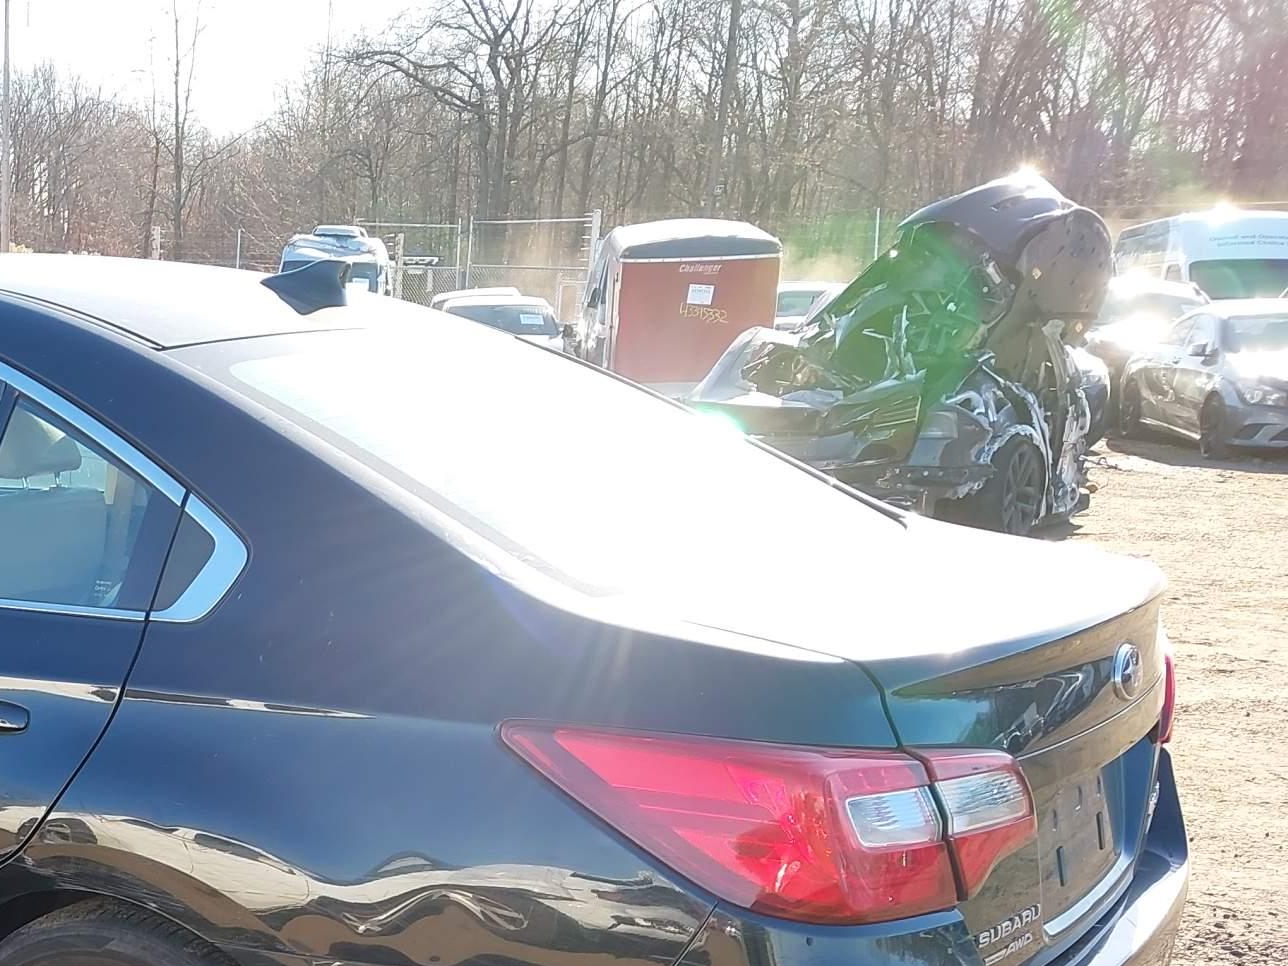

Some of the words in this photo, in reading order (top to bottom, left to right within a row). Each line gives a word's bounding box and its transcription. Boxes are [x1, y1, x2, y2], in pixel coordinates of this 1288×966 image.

[679, 264, 722, 272] Challenger
[978, 903, 1041, 949] SUBARU
[1005, 931, 1033, 958] AWD
